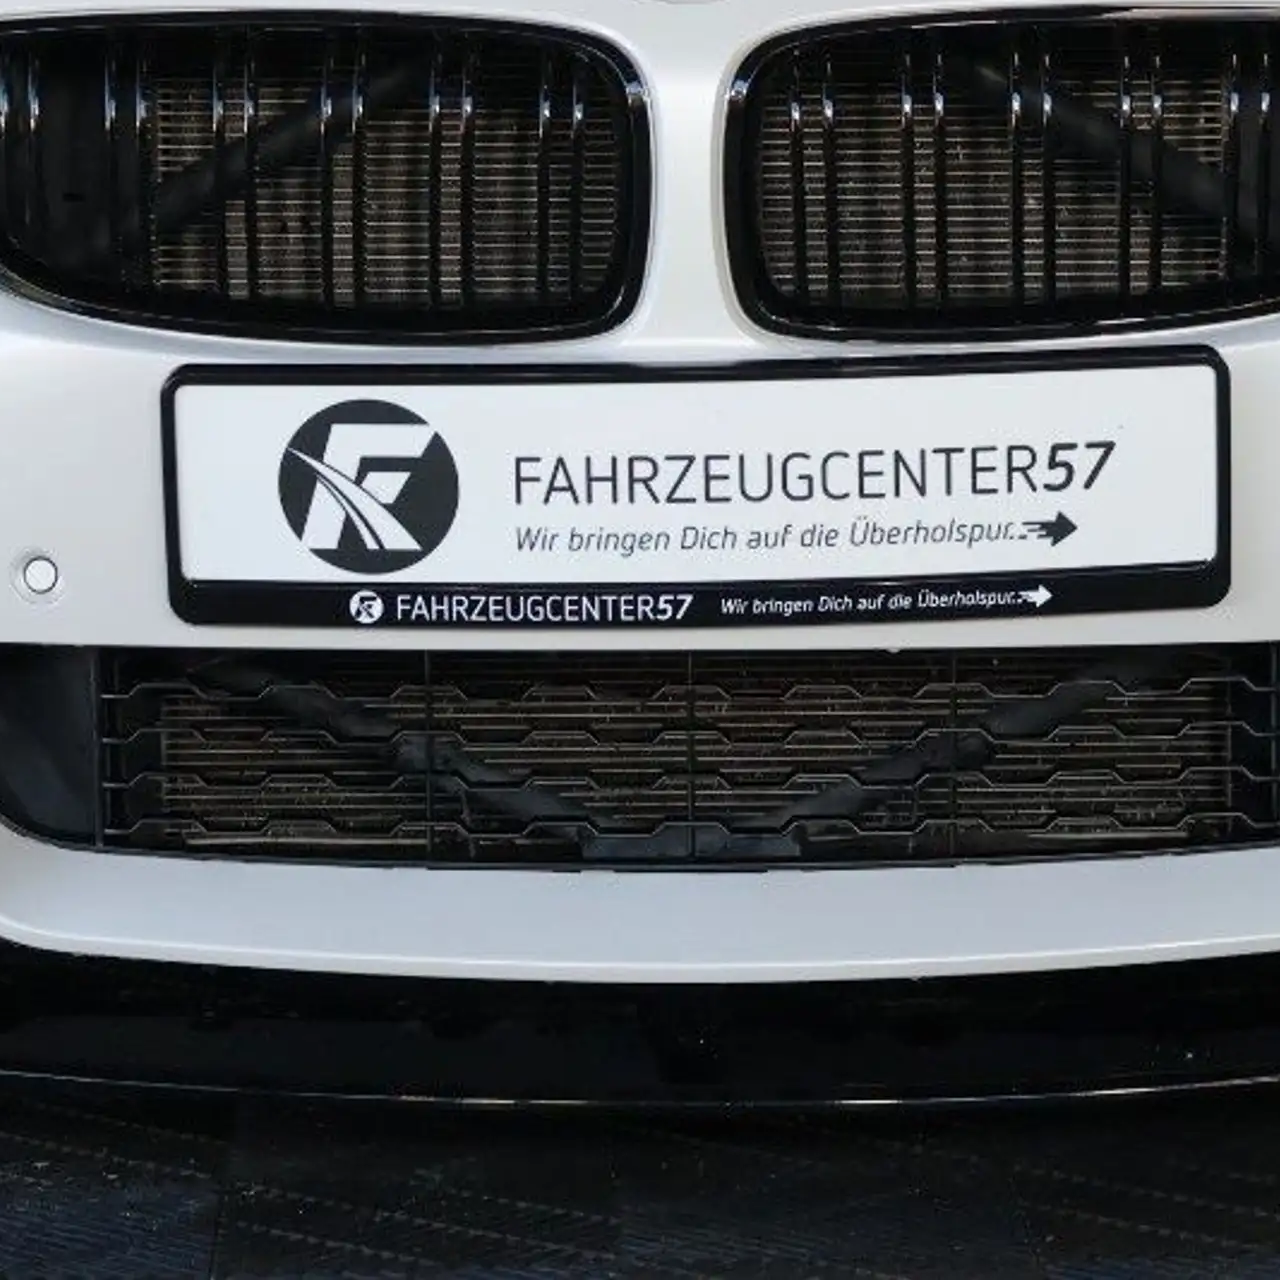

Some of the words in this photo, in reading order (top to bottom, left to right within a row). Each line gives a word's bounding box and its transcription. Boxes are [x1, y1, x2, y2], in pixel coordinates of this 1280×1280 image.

[514, 440, 1117, 505] FAHRZEUGCENTER57
[516, 526, 560, 552] Wir
[568, 527, 671, 558] bringen
[680, 526, 738, 551] Dich
[746, 523, 794, 550] auf
[800, 522, 840, 548] die
[396, 594, 695, 622] FAHRZEUGCENTER57
[719, 598, 748, 615] Wir
[752, 597, 814, 617] bringen
[817, 595, 853, 613] Dich
[855, 593, 885, 611] auf
[887, 593, 913, 610] die
